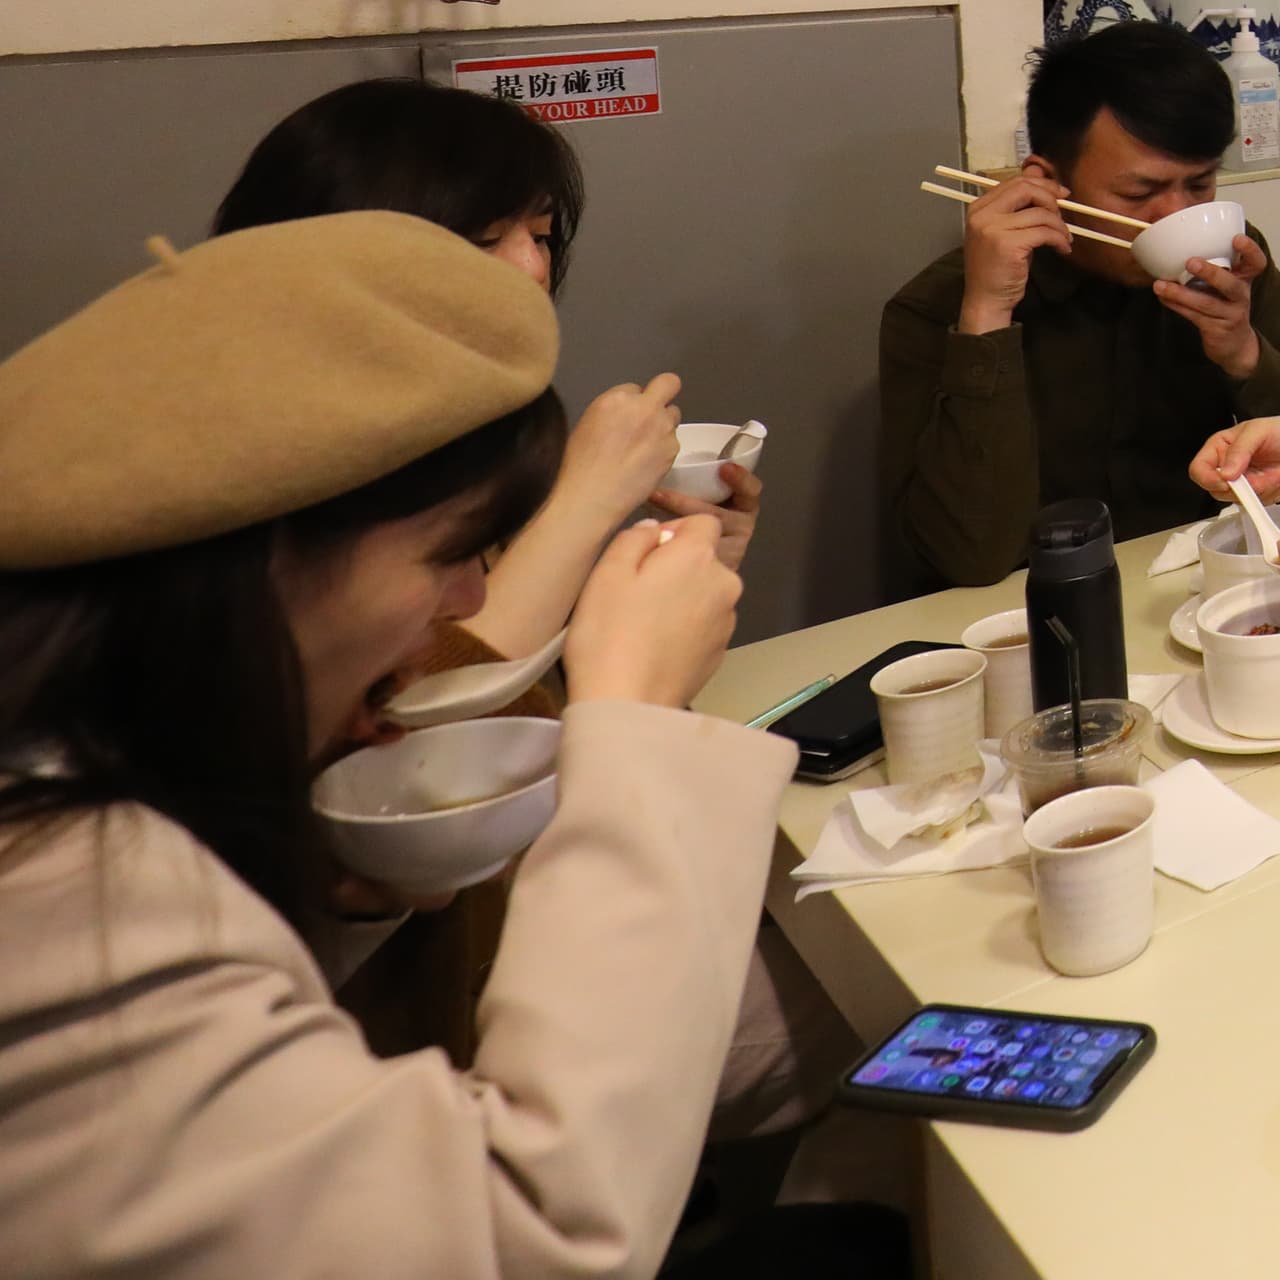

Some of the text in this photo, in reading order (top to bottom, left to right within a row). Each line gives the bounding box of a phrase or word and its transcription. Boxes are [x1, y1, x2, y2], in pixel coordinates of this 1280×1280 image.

[491, 66, 627, 100] 提防碰頭
[531, 96, 647, 119] YOUR HEAD
